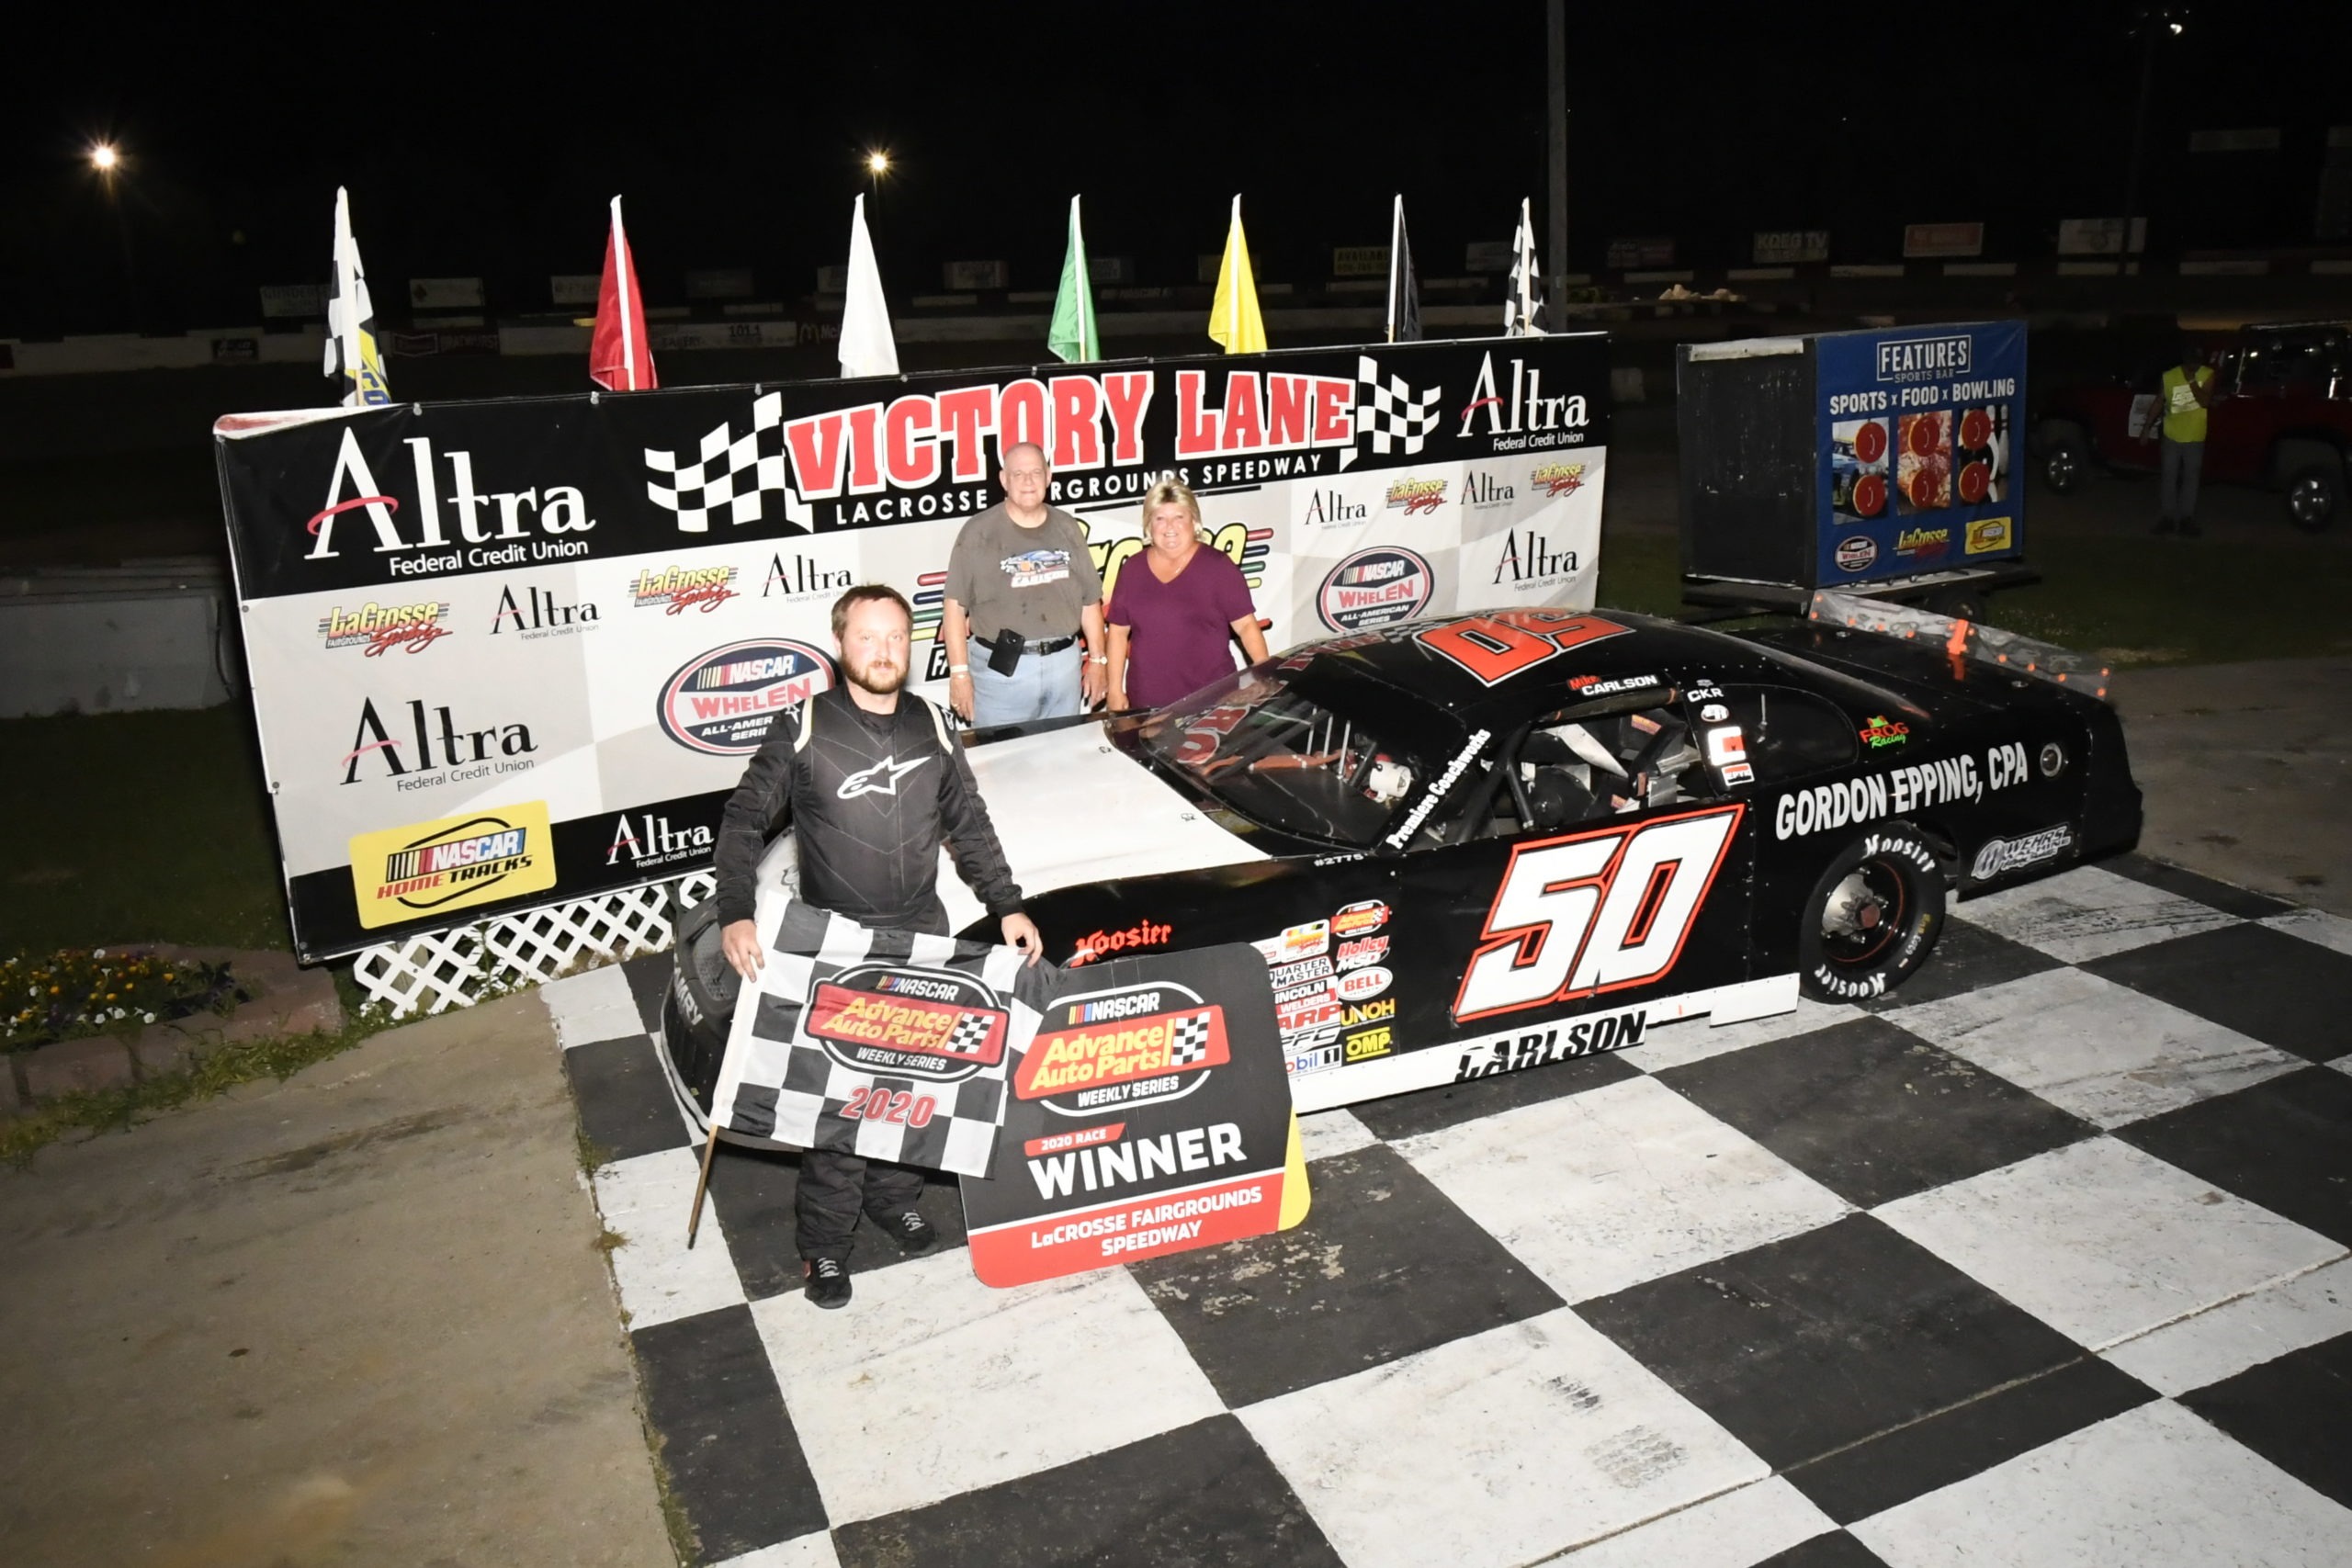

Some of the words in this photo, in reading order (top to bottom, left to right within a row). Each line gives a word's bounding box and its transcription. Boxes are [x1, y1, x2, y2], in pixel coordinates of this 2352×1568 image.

[1882, 340, 1967, 372] FEATURES
[1894, 371, 1932, 383] SPORTS
[1936, 370, 1954, 378] BAR
[1457, 350, 1589, 438] Altra
[1829, 390, 1887, 415] SPORTS
[1901, 386, 1939, 408] FOOD
[1952, 378, 2015, 402] BOWLING
[784, 370, 1154, 501] VICTORY
[1176, 370, 1356, 461] LANE
[1493, 436, 1527, 451] Federal
[1529, 433, 1555, 447] Credit
[1557, 431, 1584, 445] Union
[1461, 470, 1514, 505] Altra
[1535, 463, 1581, 482] LaCrosse
[304, 426, 596, 559] Altra
[837, 488, 988, 525] LACROSSE
[1050, 467, 1189, 501] RGROUNDS
[1204, 454, 1321, 484] SPEEDWAY
[1391, 478, 1443, 501] LaCrosse
[1305, 488, 1367, 525] Altra
[390, 550, 462, 577] Federal
[469, 544, 526, 567] Credit
[532, 539, 588, 561] Union
[1363, 559, 1405, 582] NASCAR
[1492, 526, 1579, 584] Altra
[636, 566, 729, 597] LaCrosse
[763, 552, 854, 597] Altra
[1514, 581, 1536, 592] Federal
[1538, 579, 1555, 588] Credit
[1557, 576, 1577, 584] Union
[489, 583, 602, 635] Altra
[786, 594, 810, 604] Federal
[812, 592, 831, 601] Credit
[1338, 580, 1414, 609] WHELEN
[329, 602, 439, 637] LaCrosse
[1340, 604, 1409, 622] ALL-AMERICAN
[1359, 615, 1390, 626] SERIES
[521, 629, 549, 641] Federal
[551, 627, 574, 637] Credit
[576, 625, 599, 633] Union
[729, 655, 796, 683] NASCAR
[1568, 675, 1600, 689] Mike
[1581, 675, 1657, 695] CARLSON
[692, 678, 811, 719] WHELEN
[1687, 687, 1724, 703] CKR
[340, 695, 537, 785] Altra
[701, 716, 774, 737] ALL-AMER
[1860, 722, 1909, 743] FROG
[1870, 734, 1905, 749] Racing
[396, 769, 447, 793] Federal
[450, 764, 490, 783] Credit
[496, 758, 534, 775] Union
[1385, 794, 1439, 850] Premiere
[1429, 728, 1491, 795] Coachworks
[1776, 773, 1887, 840] GORDON
[1893, 754, 1983, 814] EPPING,
[1988, 742, 2028, 791] CPA
[430, 829, 523, 869] NASCAR
[605, 814, 714, 865] Altra
[1861, 834, 1935, 872] Hoosier
[636, 855, 662, 869] Federal
[664, 851, 688, 863] Credit
[690, 845, 711, 859] Union
[377, 873, 444, 899] HOME
[449, 854, 533, 885] TRACKS
[1455, 805, 1745, 1022] 50
[1069, 919, 1171, 967] Hoosier
[895, 977, 959, 1001] NASCAR
[1275, 980, 1324, 1004] INCOLN
[1276, 965, 1329, 987] MASTER
[1344, 974, 1383, 992] BELL
[1814, 964, 1886, 998] Hoosier
[842, 997, 953, 1032] Advance
[1091, 992, 1160, 1021] NASCAR
[1278, 1003, 1341, 1030] ARP
[1280, 993, 1330, 1013] WELDERS
[1340, 998, 1395, 1026] UNOH
[821, 1014, 883, 1039] Auto
[882, 1022, 941, 1048] Parts
[1042, 1025, 1165, 1066] Advance
[1347, 1032, 1390, 1055] OMP
[855, 1046, 905, 1066] WEEKLY
[903, 1054, 947, 1071] SERIES
[1029, 1062, 1094, 1090] Auto
[1095, 1047, 1161, 1078] Parts
[1285, 1053, 1317, 1073] obil
[839, 1086, 937, 1128] 2020
[1078, 1084, 1131, 1108] WEEKLY
[1132, 1076, 1179, 1098] SERIES
[1041, 1137, 1072, 1151] 2020
[1075, 1129, 1106, 1145] RACE
[1027, 1122, 1248, 1201] WINNER
[1031, 1213, 1126, 1249] LaCROSSE
[1131, 1186, 1262, 1227] FAIRGROUNDS
[1102, 1220, 1203, 1257] SPEEDWAY
